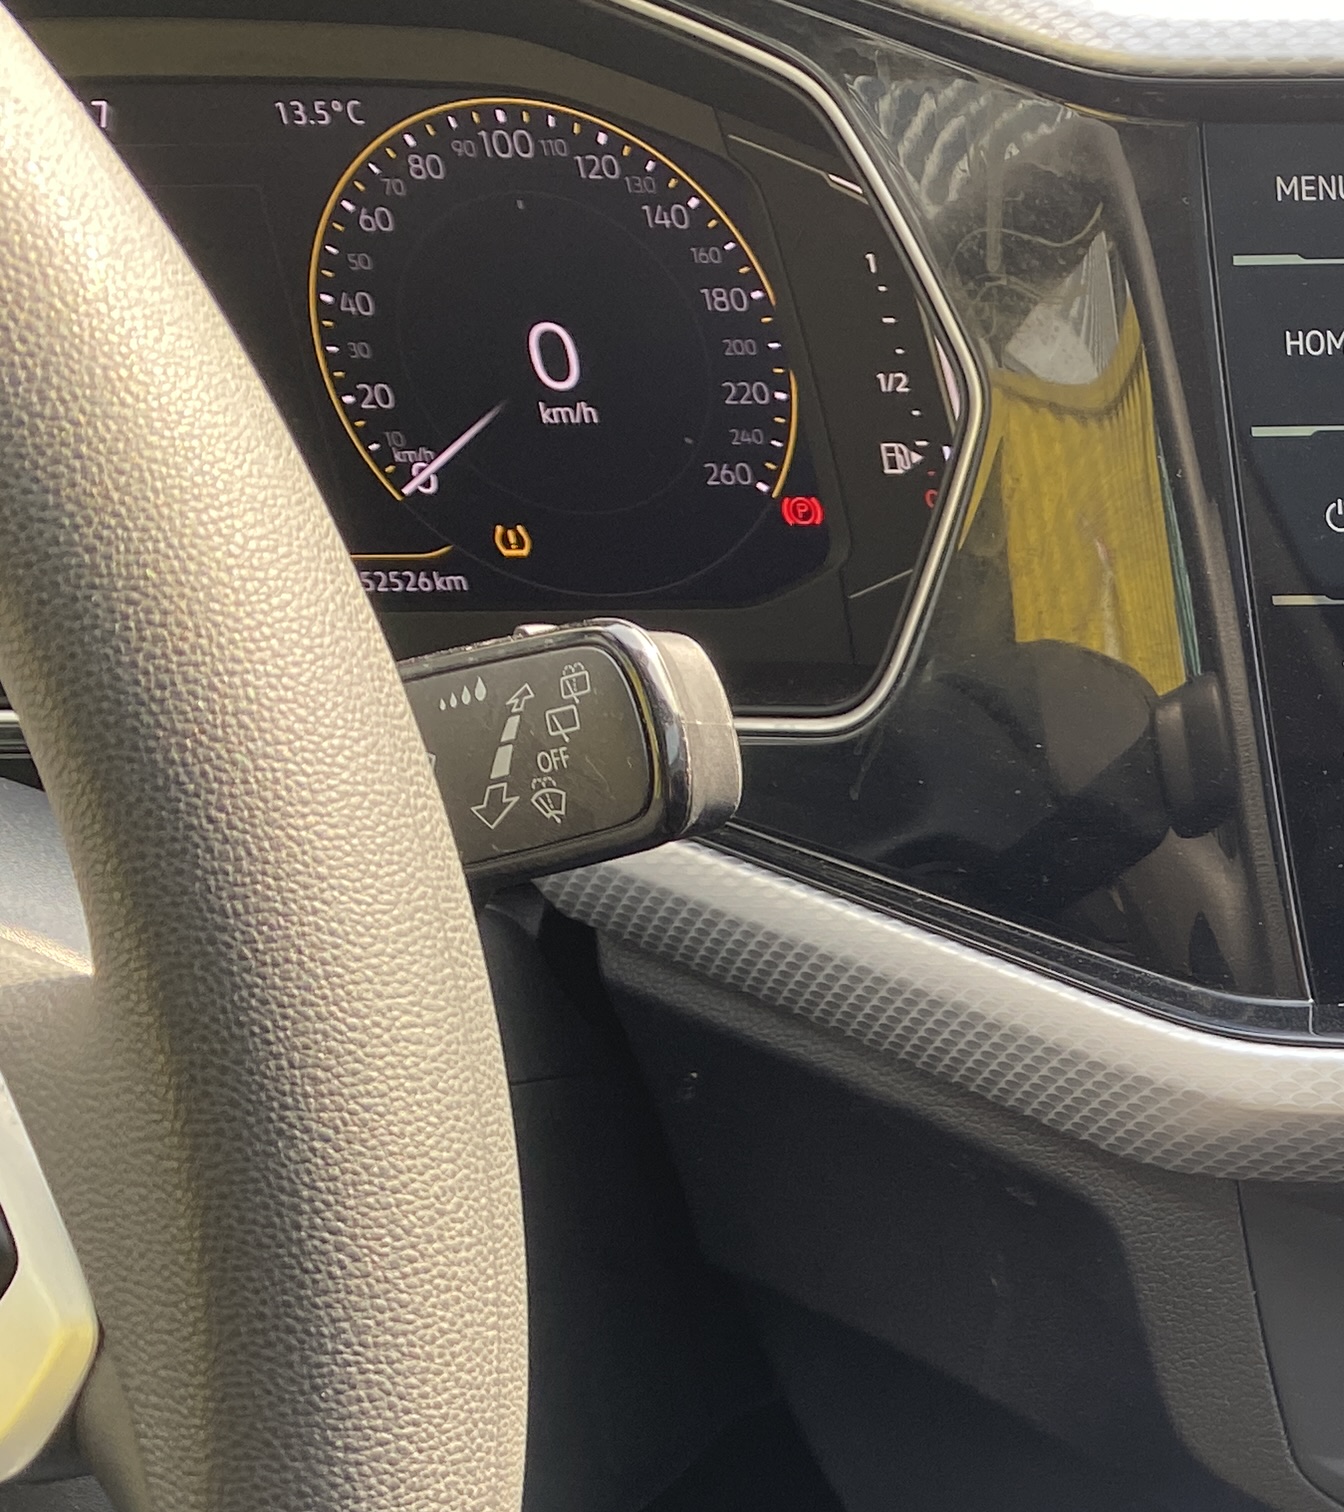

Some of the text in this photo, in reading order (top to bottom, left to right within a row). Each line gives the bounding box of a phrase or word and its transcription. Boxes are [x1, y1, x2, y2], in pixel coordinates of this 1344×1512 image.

[274, 100, 366, 126] 13.5°C
[451, 139, 477, 158] 90
[478, 129, 534, 158] 100
[538, 138, 568, 157] 110
[408, 153, 446, 180] 80
[574, 154, 621, 179] 120
[380, 177, 406, 196] 70
[624, 175, 657, 195] 130
[358, 206, 393, 232] 60
[641, 203, 691, 230] 140
[347, 253, 373, 270] 50
[690, 247, 722, 264] 160
[864, 253, 877, 273] 1
[340, 291, 375, 316] 40
[700, 287, 749, 312] 180
[347, 341, 371, 358] 30
[527, 321, 581, 391] 0
[721, 338, 757, 356] 200
[720, 381, 770, 405] 220
[876, 372, 911, 393] 1/2
[355, 383, 395, 409] 20
[538, 402, 598, 424] km/h
[385, 431, 406, 448] 10
[728, 428, 765, 446] 240
[703, 462, 753, 486] 260
[537, 746, 571, 773] OFF
